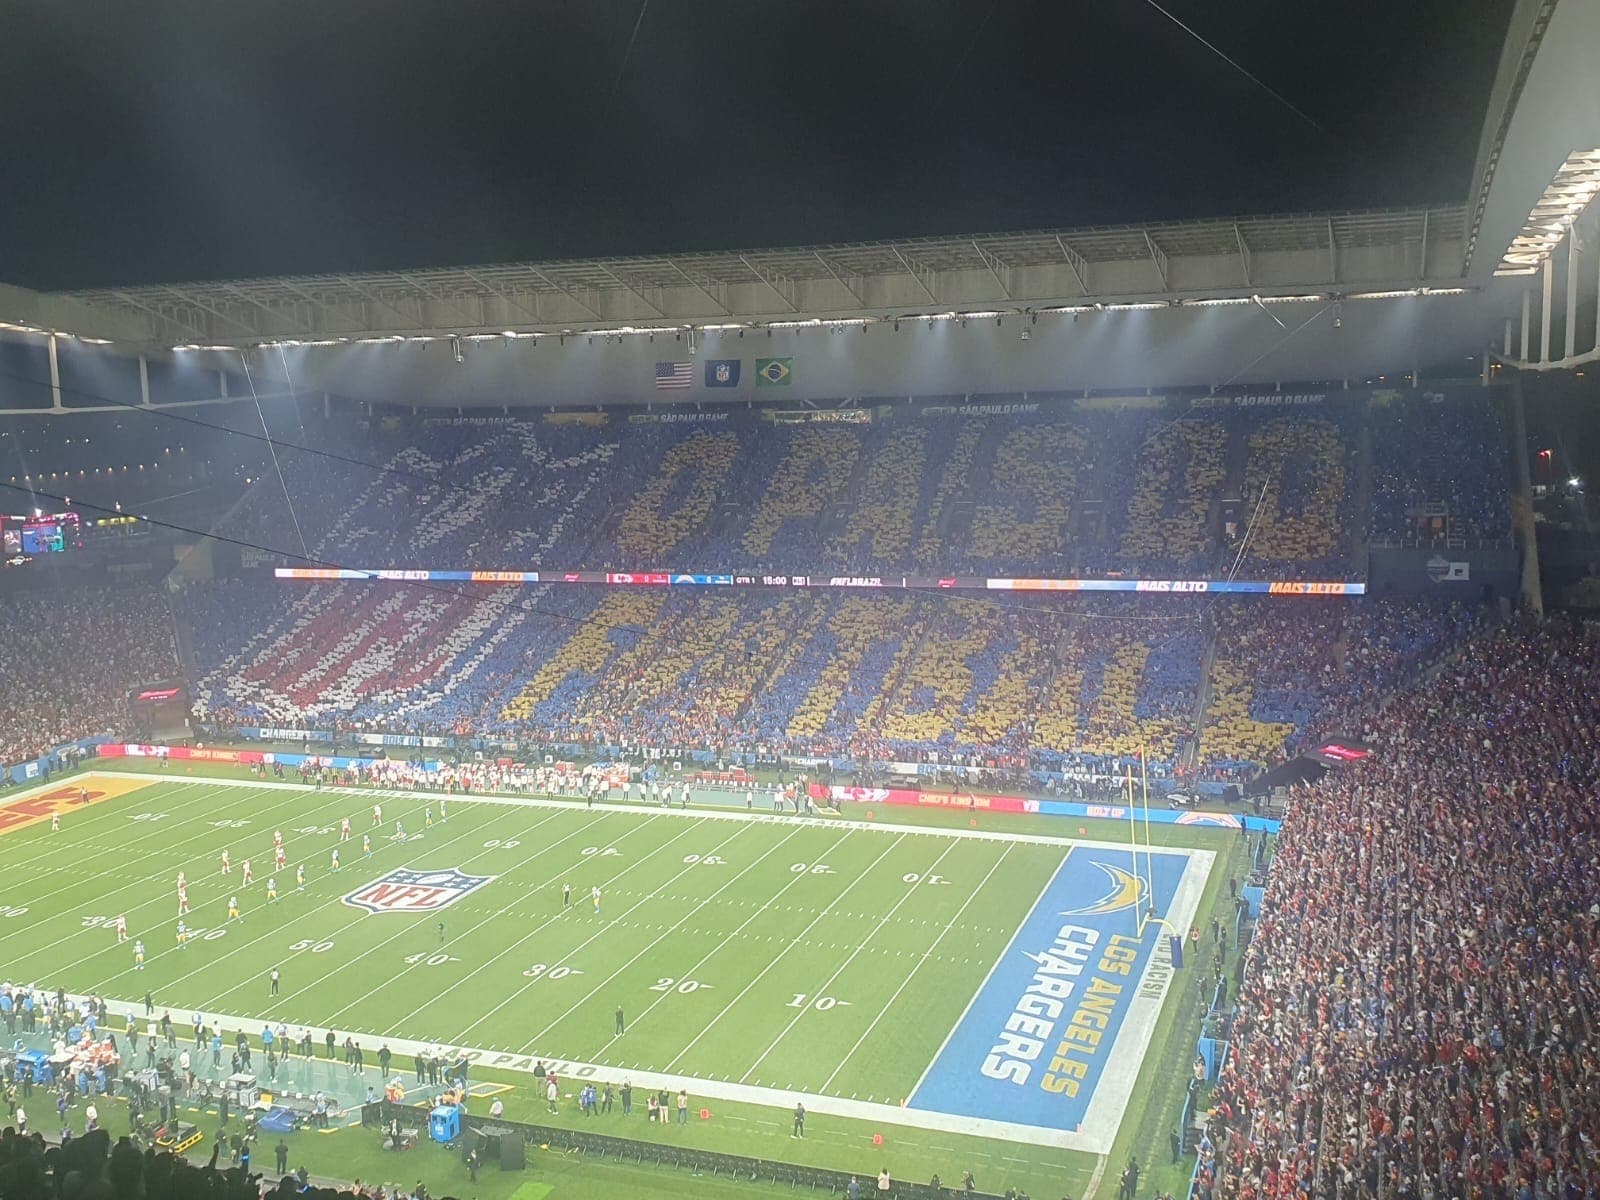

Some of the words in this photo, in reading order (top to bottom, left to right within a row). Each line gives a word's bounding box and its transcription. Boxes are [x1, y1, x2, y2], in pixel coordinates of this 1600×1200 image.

[762, 576, 787, 585] 15:00
[1136, 580, 1171, 591] MAIS
[1172, 581, 1208, 592] ALTO
[1269, 582, 1306, 593] MAIS
[1307, 583, 1345, 594] ALTO
[357, 884, 450, 907] NFL
[289, 939, 335, 953] 50
[402, 952, 449, 966] 40
[1098, 934, 1143, 976] LOS
[522, 963, 571, 980] 30
[648, 977, 699, 994] 20
[785, 993, 837, 1011] 10
[980, 924, 1100, 1086] CHARGERS
[1040, 976, 1123, 1099] ANGELES
